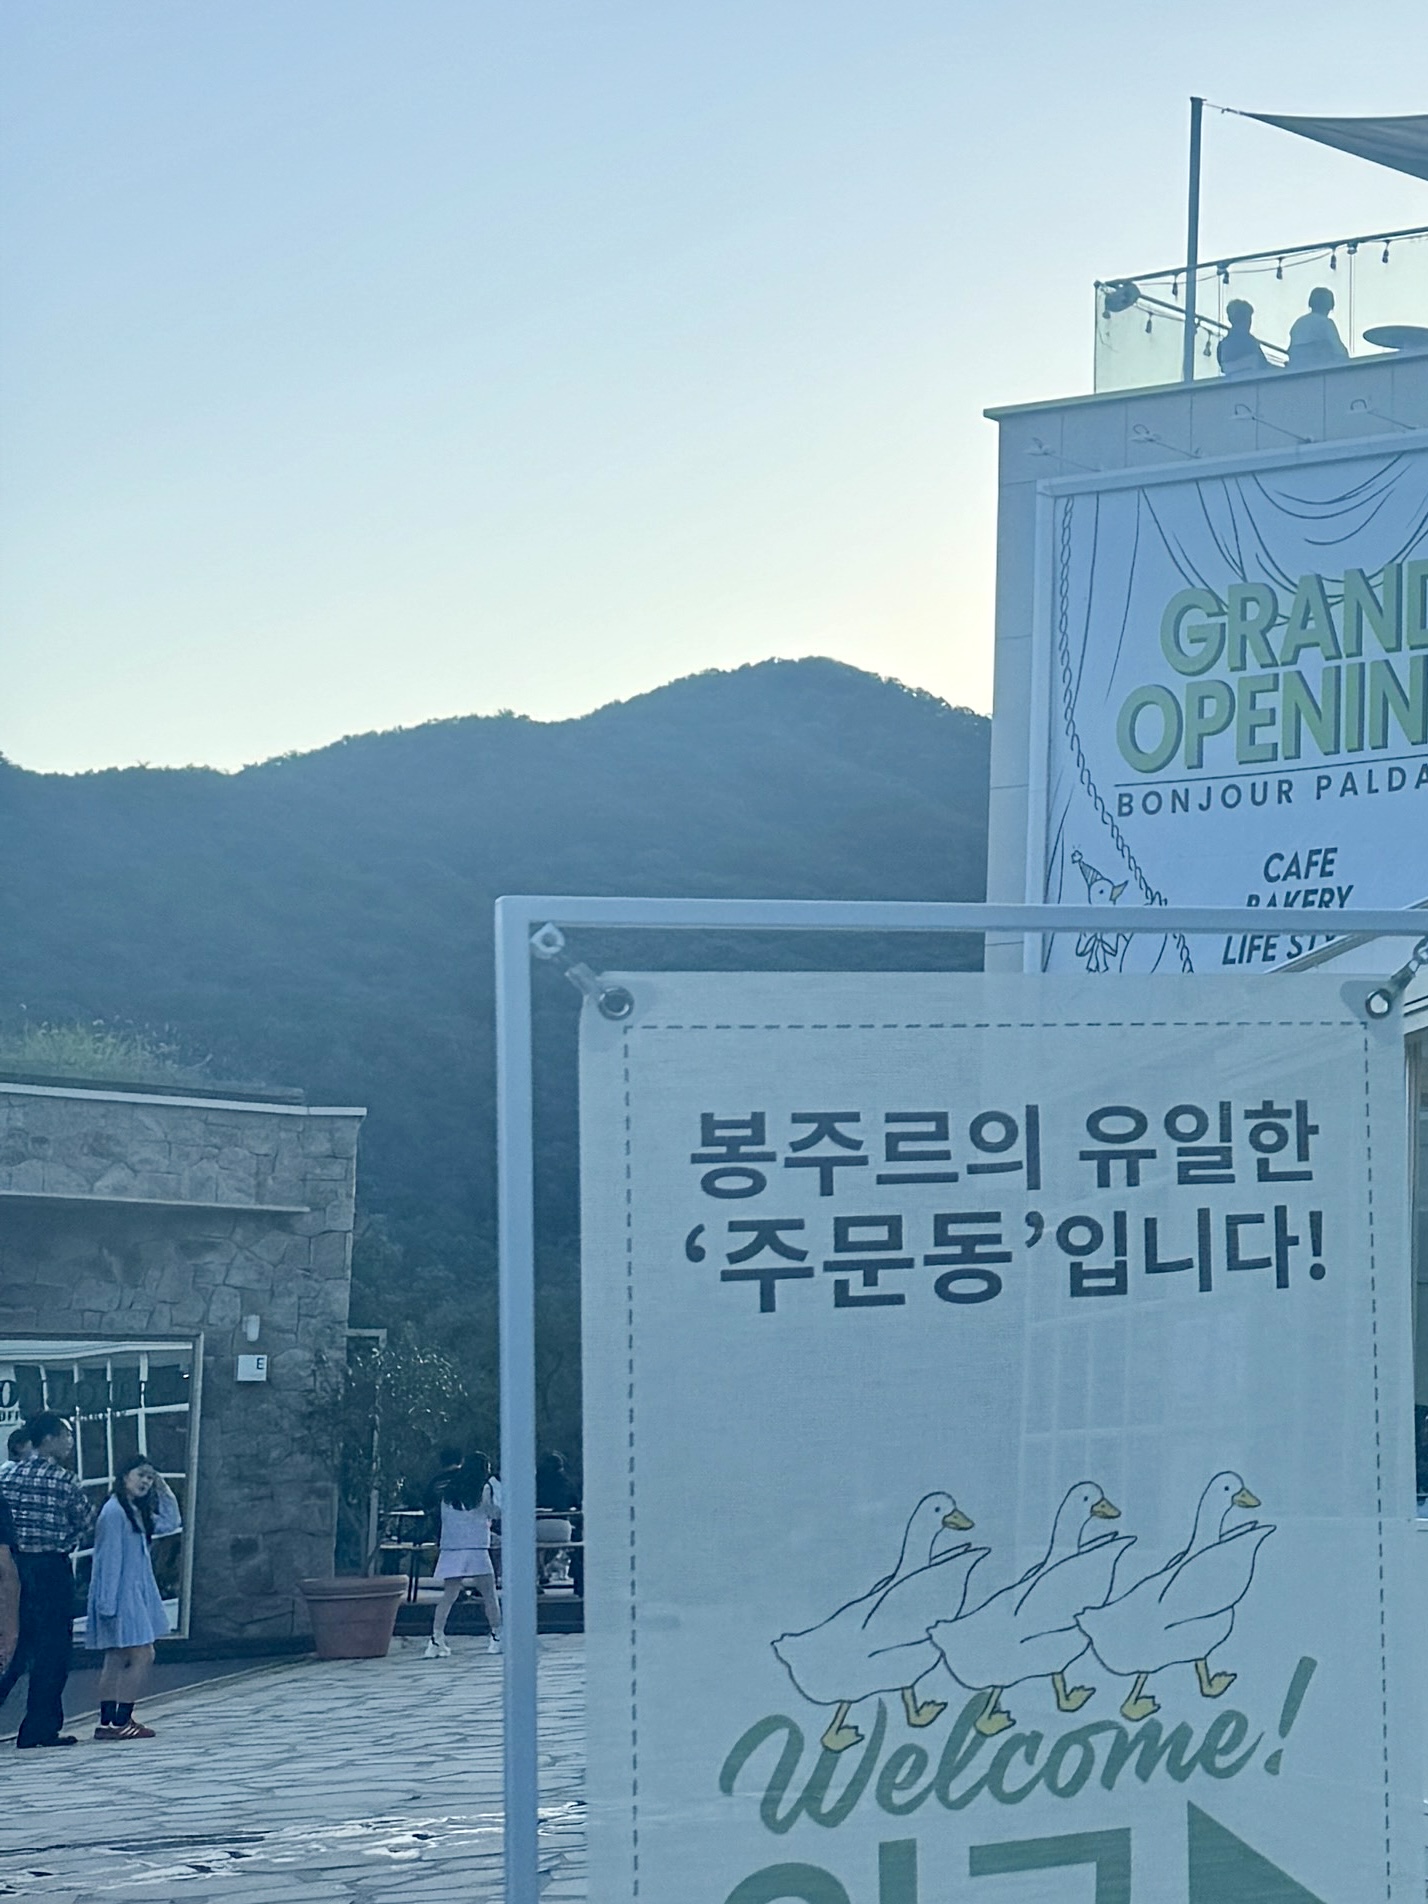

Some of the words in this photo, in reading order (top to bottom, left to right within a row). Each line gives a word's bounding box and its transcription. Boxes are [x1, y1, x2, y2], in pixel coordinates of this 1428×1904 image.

[1117, 781, 1295, 818] BONJOUR
[1263, 847, 1338, 884] CAFE
[1222, 934, 1280, 965] LIFE
[690, 1104, 1041, 1201] 봉주르의
[1080, 1101, 1319, 1187] 유일한
[719, 1656, 1317, 1834] Welcome!
